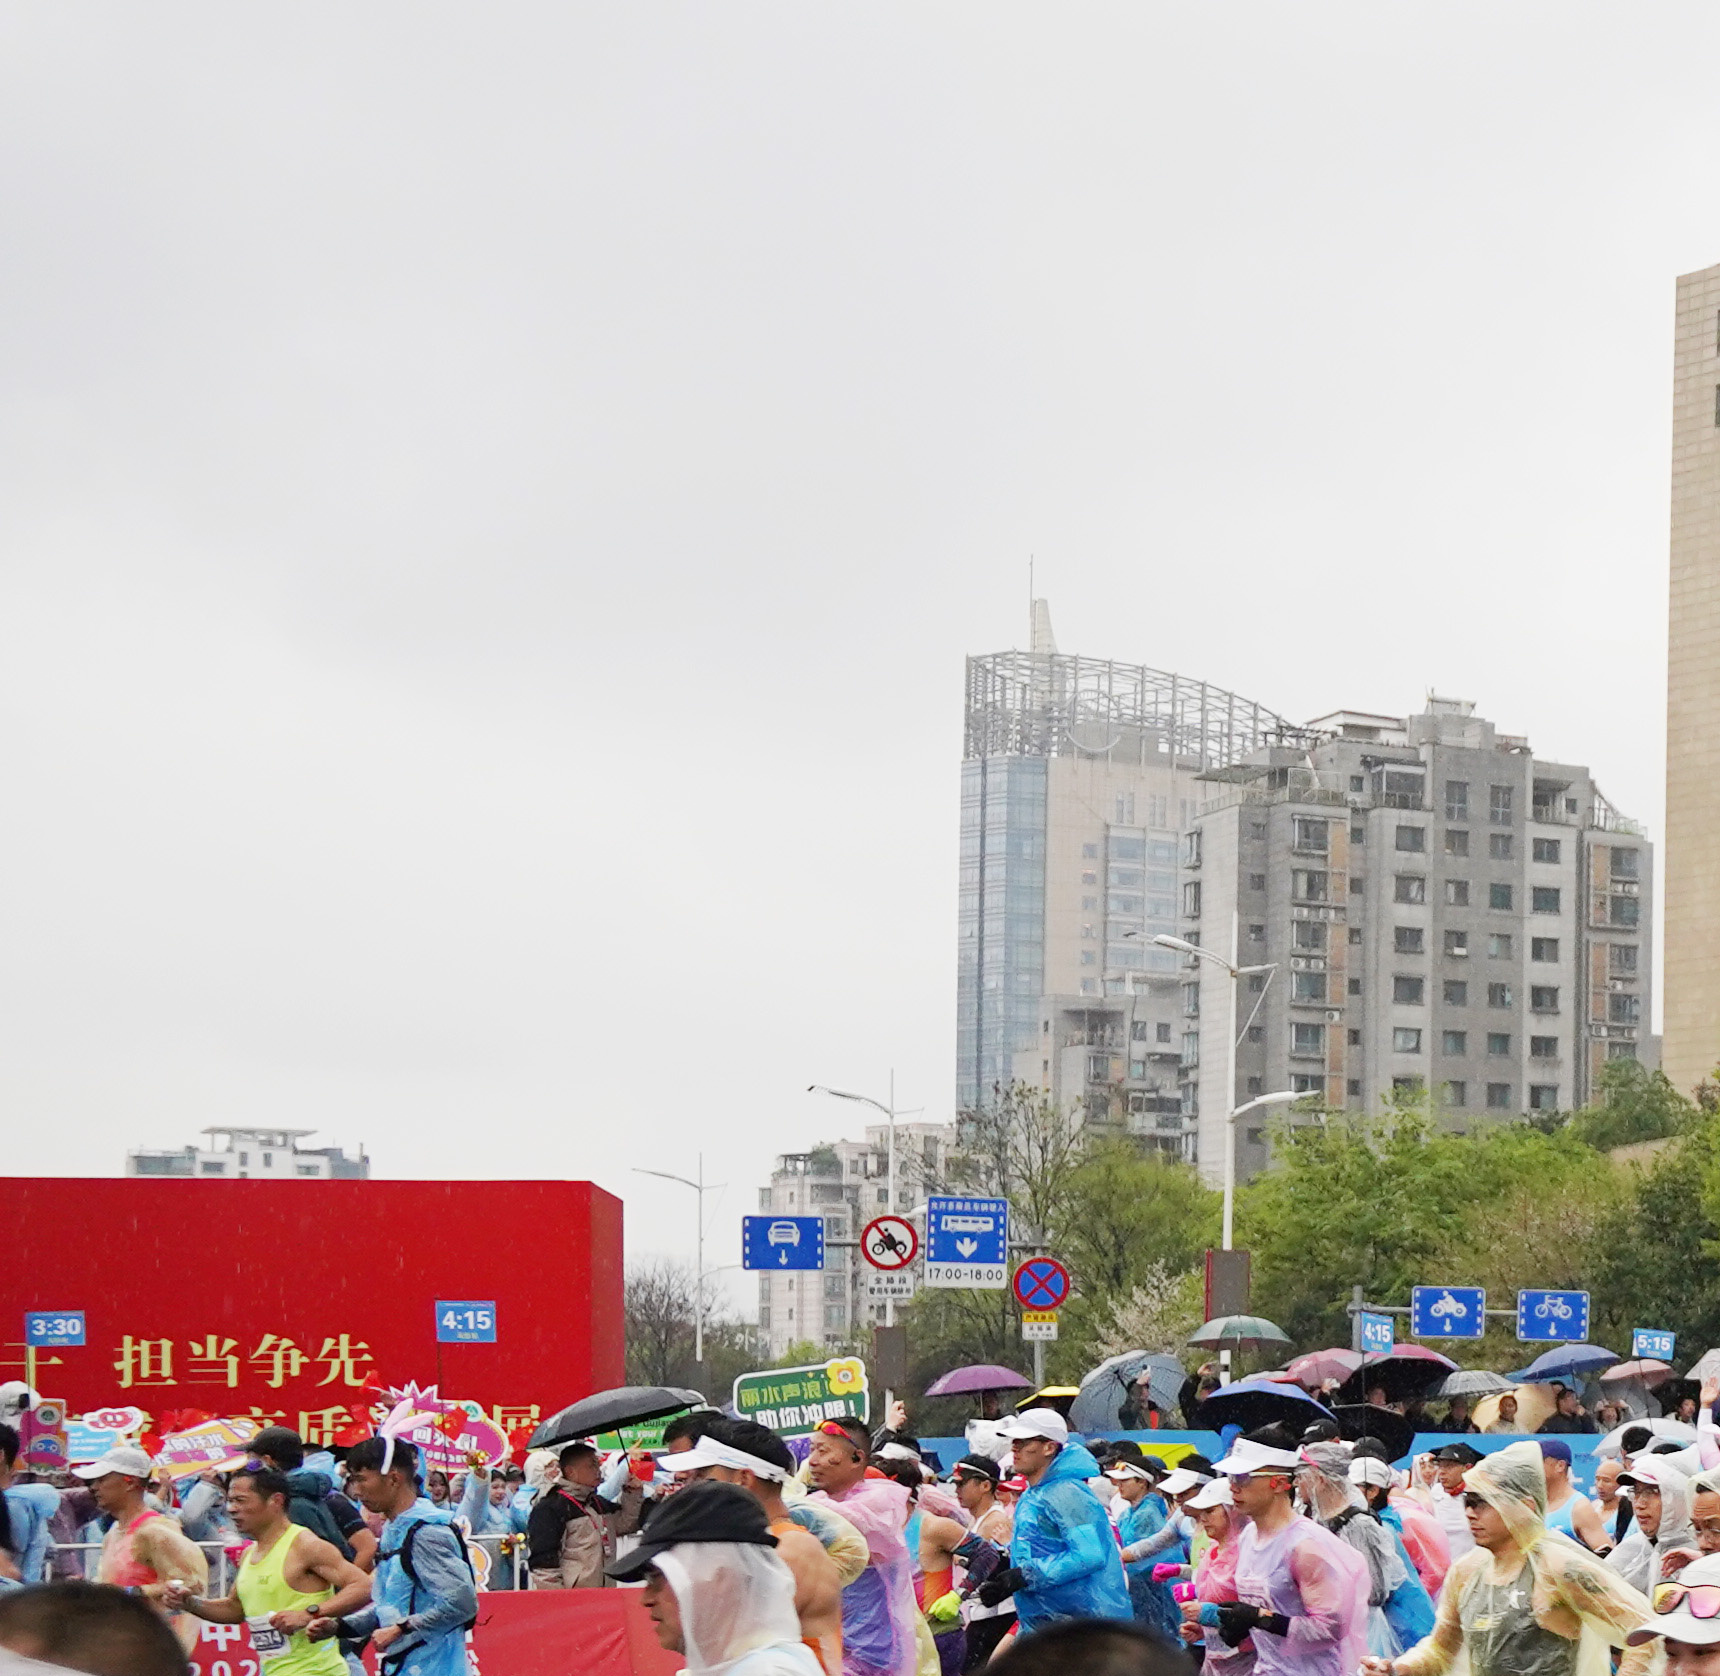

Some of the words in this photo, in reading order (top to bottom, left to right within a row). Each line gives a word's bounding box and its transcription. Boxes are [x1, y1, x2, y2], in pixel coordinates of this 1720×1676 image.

[929, 1267, 1003, 1281] 17:00-18:00
[32, 1318, 81, 1336] 3:30
[442, 1310, 492, 1330] 4:15
[1364, 1322, 1391, 1344] 4:15
[1637, 1333, 1673, 1352] 5:15
[113, 1333, 374, 1388] 担当争先
